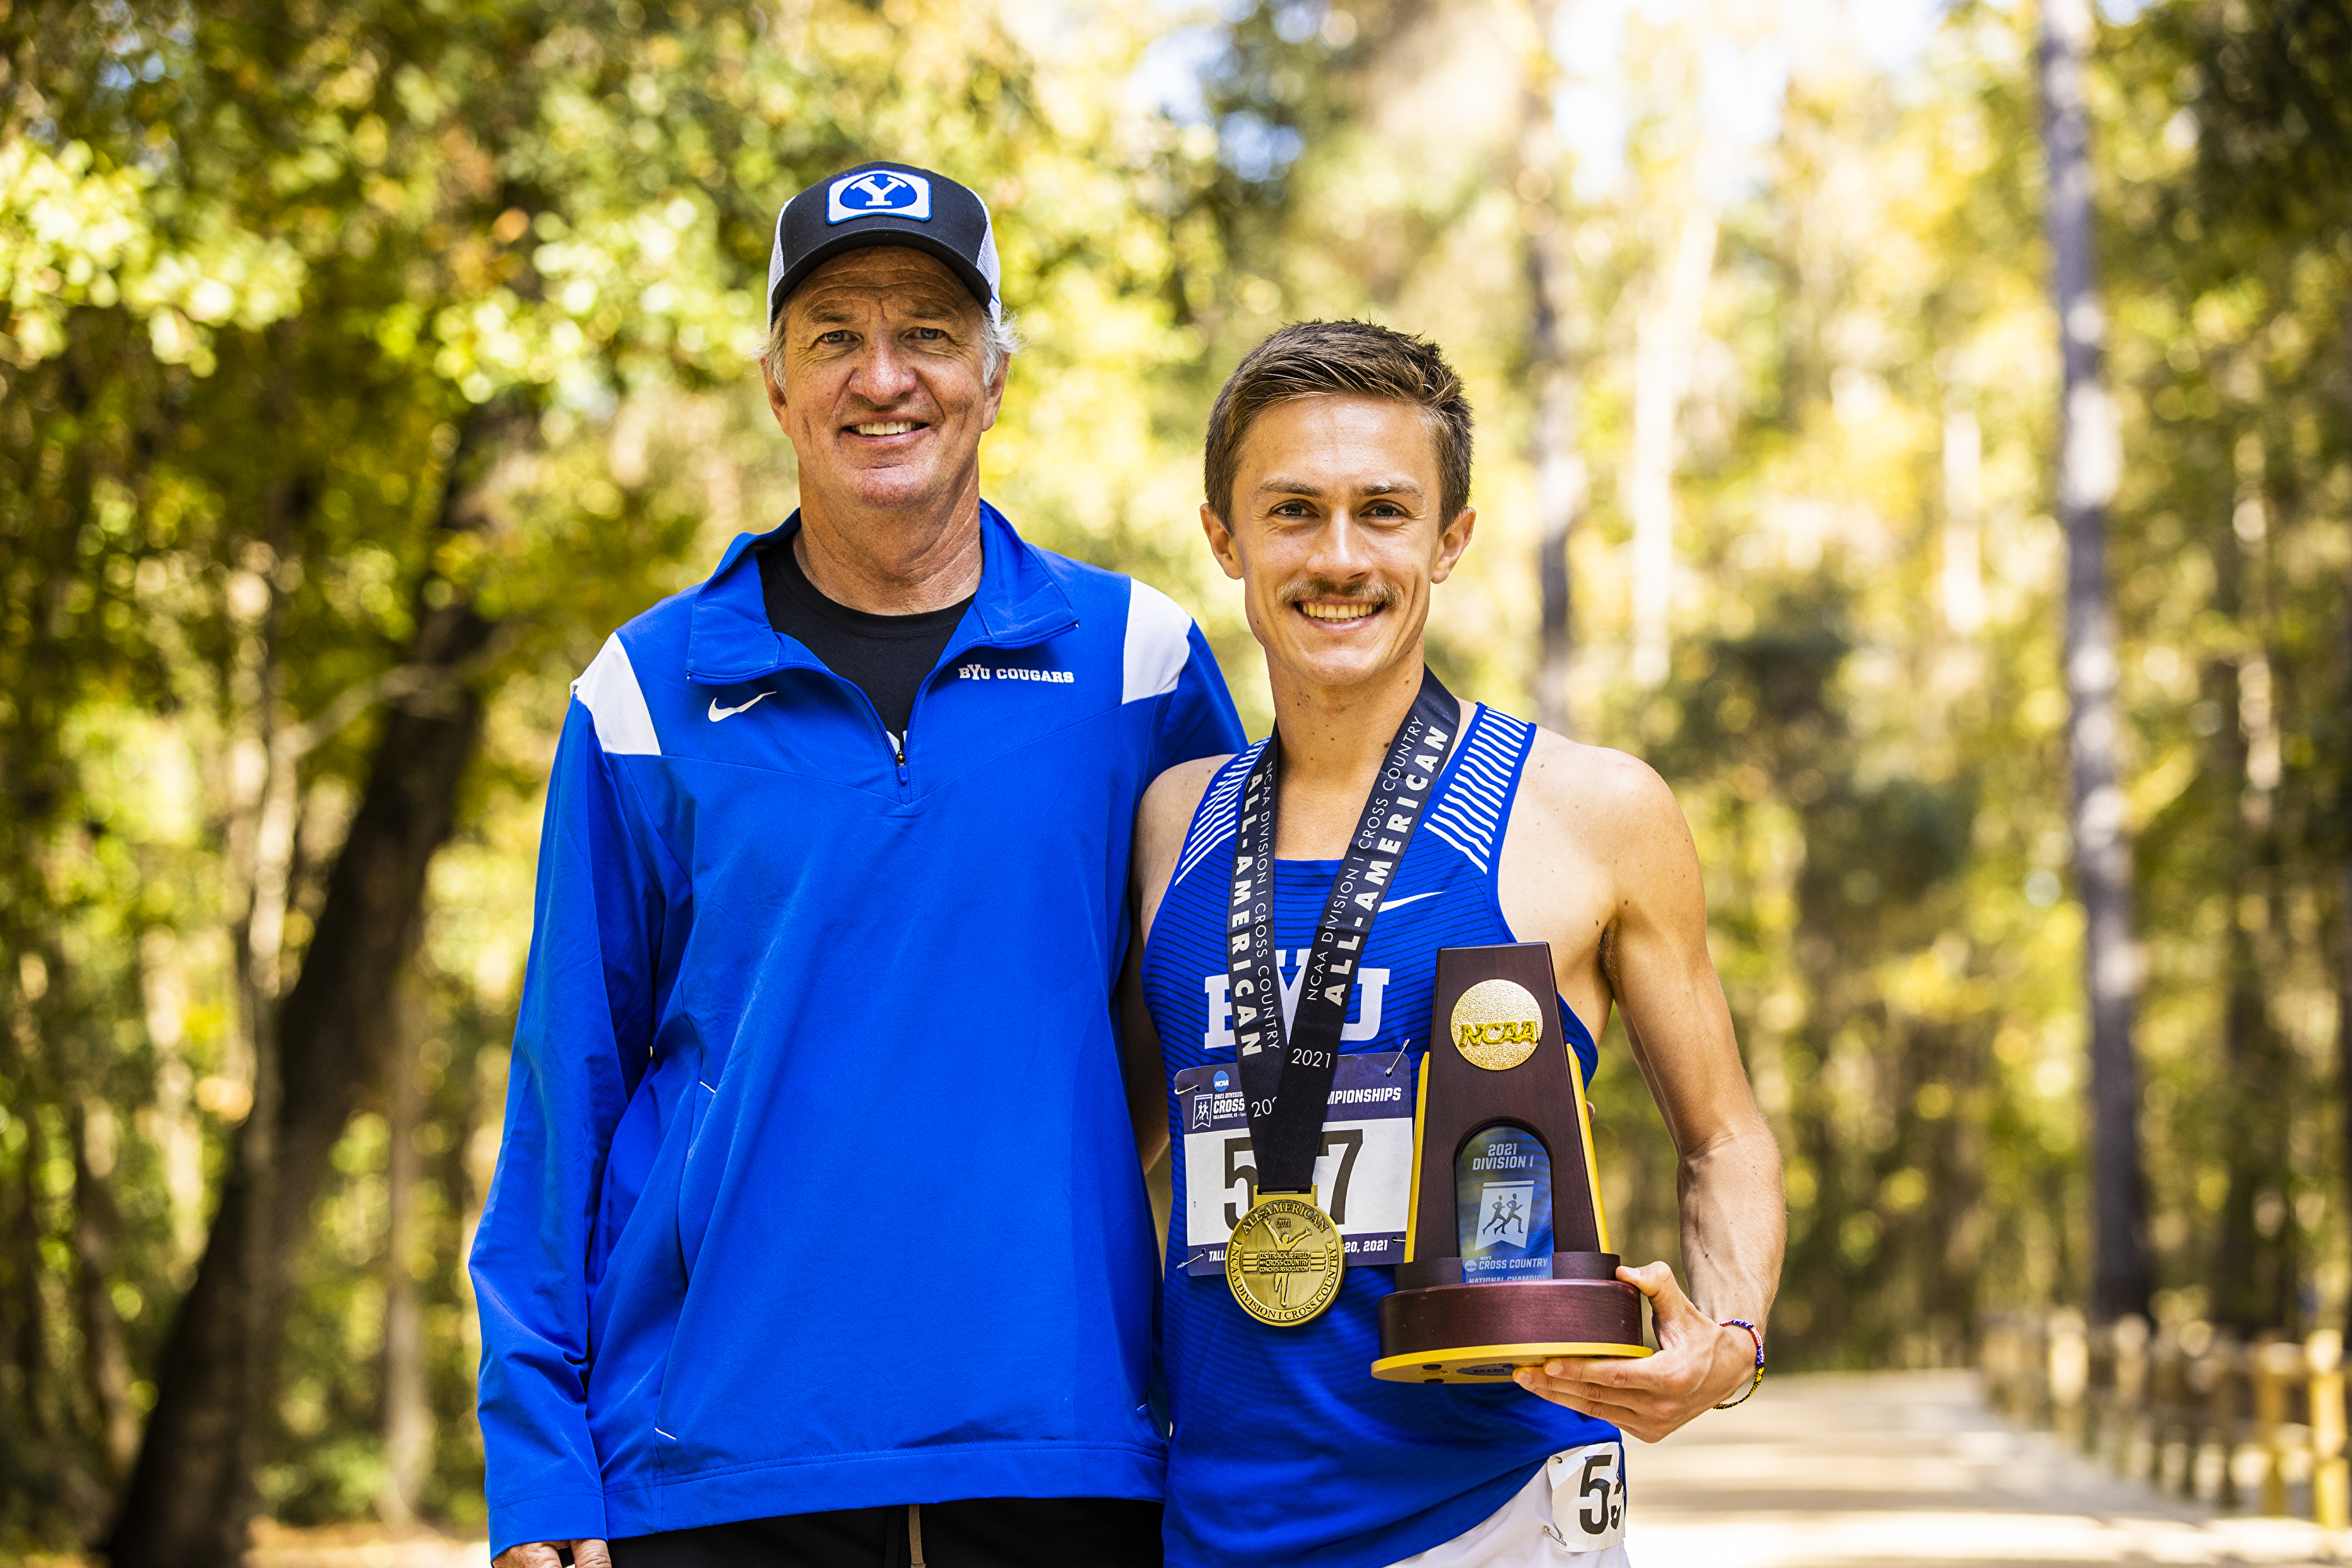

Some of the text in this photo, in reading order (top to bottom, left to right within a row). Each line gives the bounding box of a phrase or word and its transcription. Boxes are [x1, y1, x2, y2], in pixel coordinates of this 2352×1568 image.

[850, 176, 907, 206] Y
[959, 664, 1074, 683] BYU COUGARS
[1262, 760, 1273, 806] NCAA
[1257, 811, 1270, 884] DIVISION
[1307, 951, 1328, 1000] NCAA
[1321, 868, 1359, 942] DIVISION
[1358, 797, 1388, 849] CROSS
[1382, 716, 1424, 791] COUNTRY
[1324, 725, 1448, 1007] ALL-AMERICAN
[1232, 773, 1263, 1057] ALL-AMERICAN
[1254, 902, 1268, 958] CROSS
[1258, 965, 1279, 1049] COUNTRY
[1459, 1020, 1538, 1047] NCAA
[1291, 1048, 1331, 1069] 2021
[1213, 1098, 1246, 1114] CROSS
[1251, 1096, 1278, 1118] 20
[1472, 1155, 1534, 1171] DIVISION I
[1487, 1143, 1517, 1156] 2021
[1243, 1202, 1330, 1235] ALL-AMERICAN
[1277, 1219, 1291, 1228] 2021
[1363, 1240, 1388, 1252] 2021
[1479, 1258, 1548, 1270] CROSS COUNTRY
[1230, 1249, 1240, 1283] NCAA
[1236, 1284, 1276, 1319] DIVISION
[1284, 1301, 1317, 1320] CROSS
[1316, 1248, 1338, 1303] COUNTRY
